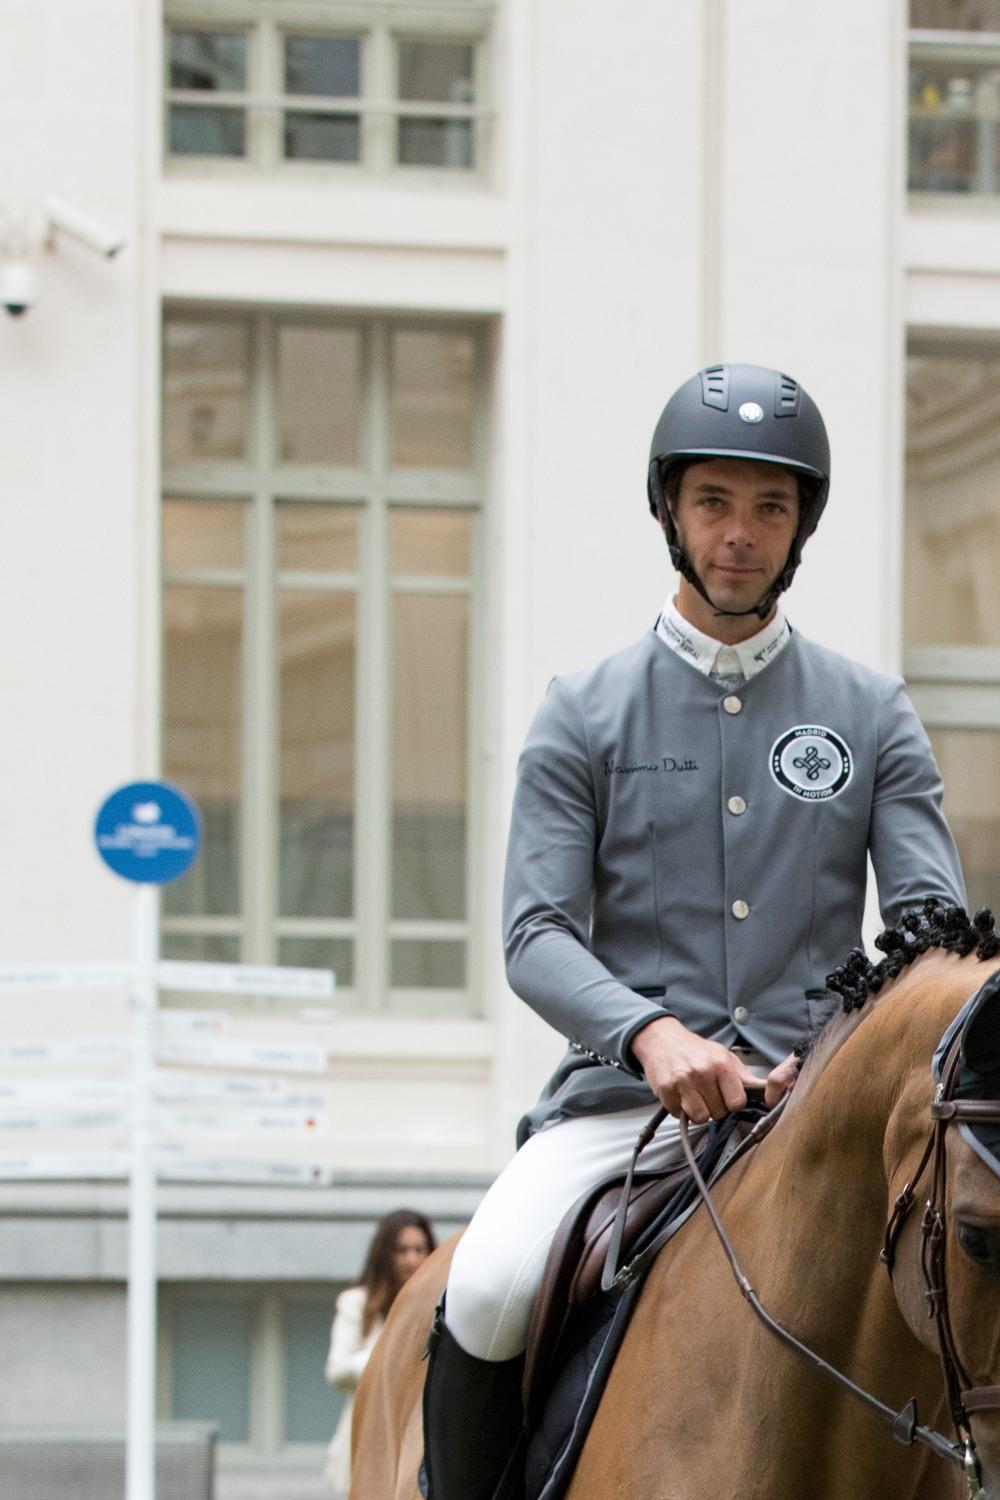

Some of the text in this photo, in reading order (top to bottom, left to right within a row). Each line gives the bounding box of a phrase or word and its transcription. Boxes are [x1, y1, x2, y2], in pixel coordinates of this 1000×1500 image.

[795, 729, 827, 737] MADRID
[662, 757, 699, 772] Dutti
[793, 785, 834, 798] IN MOTION
